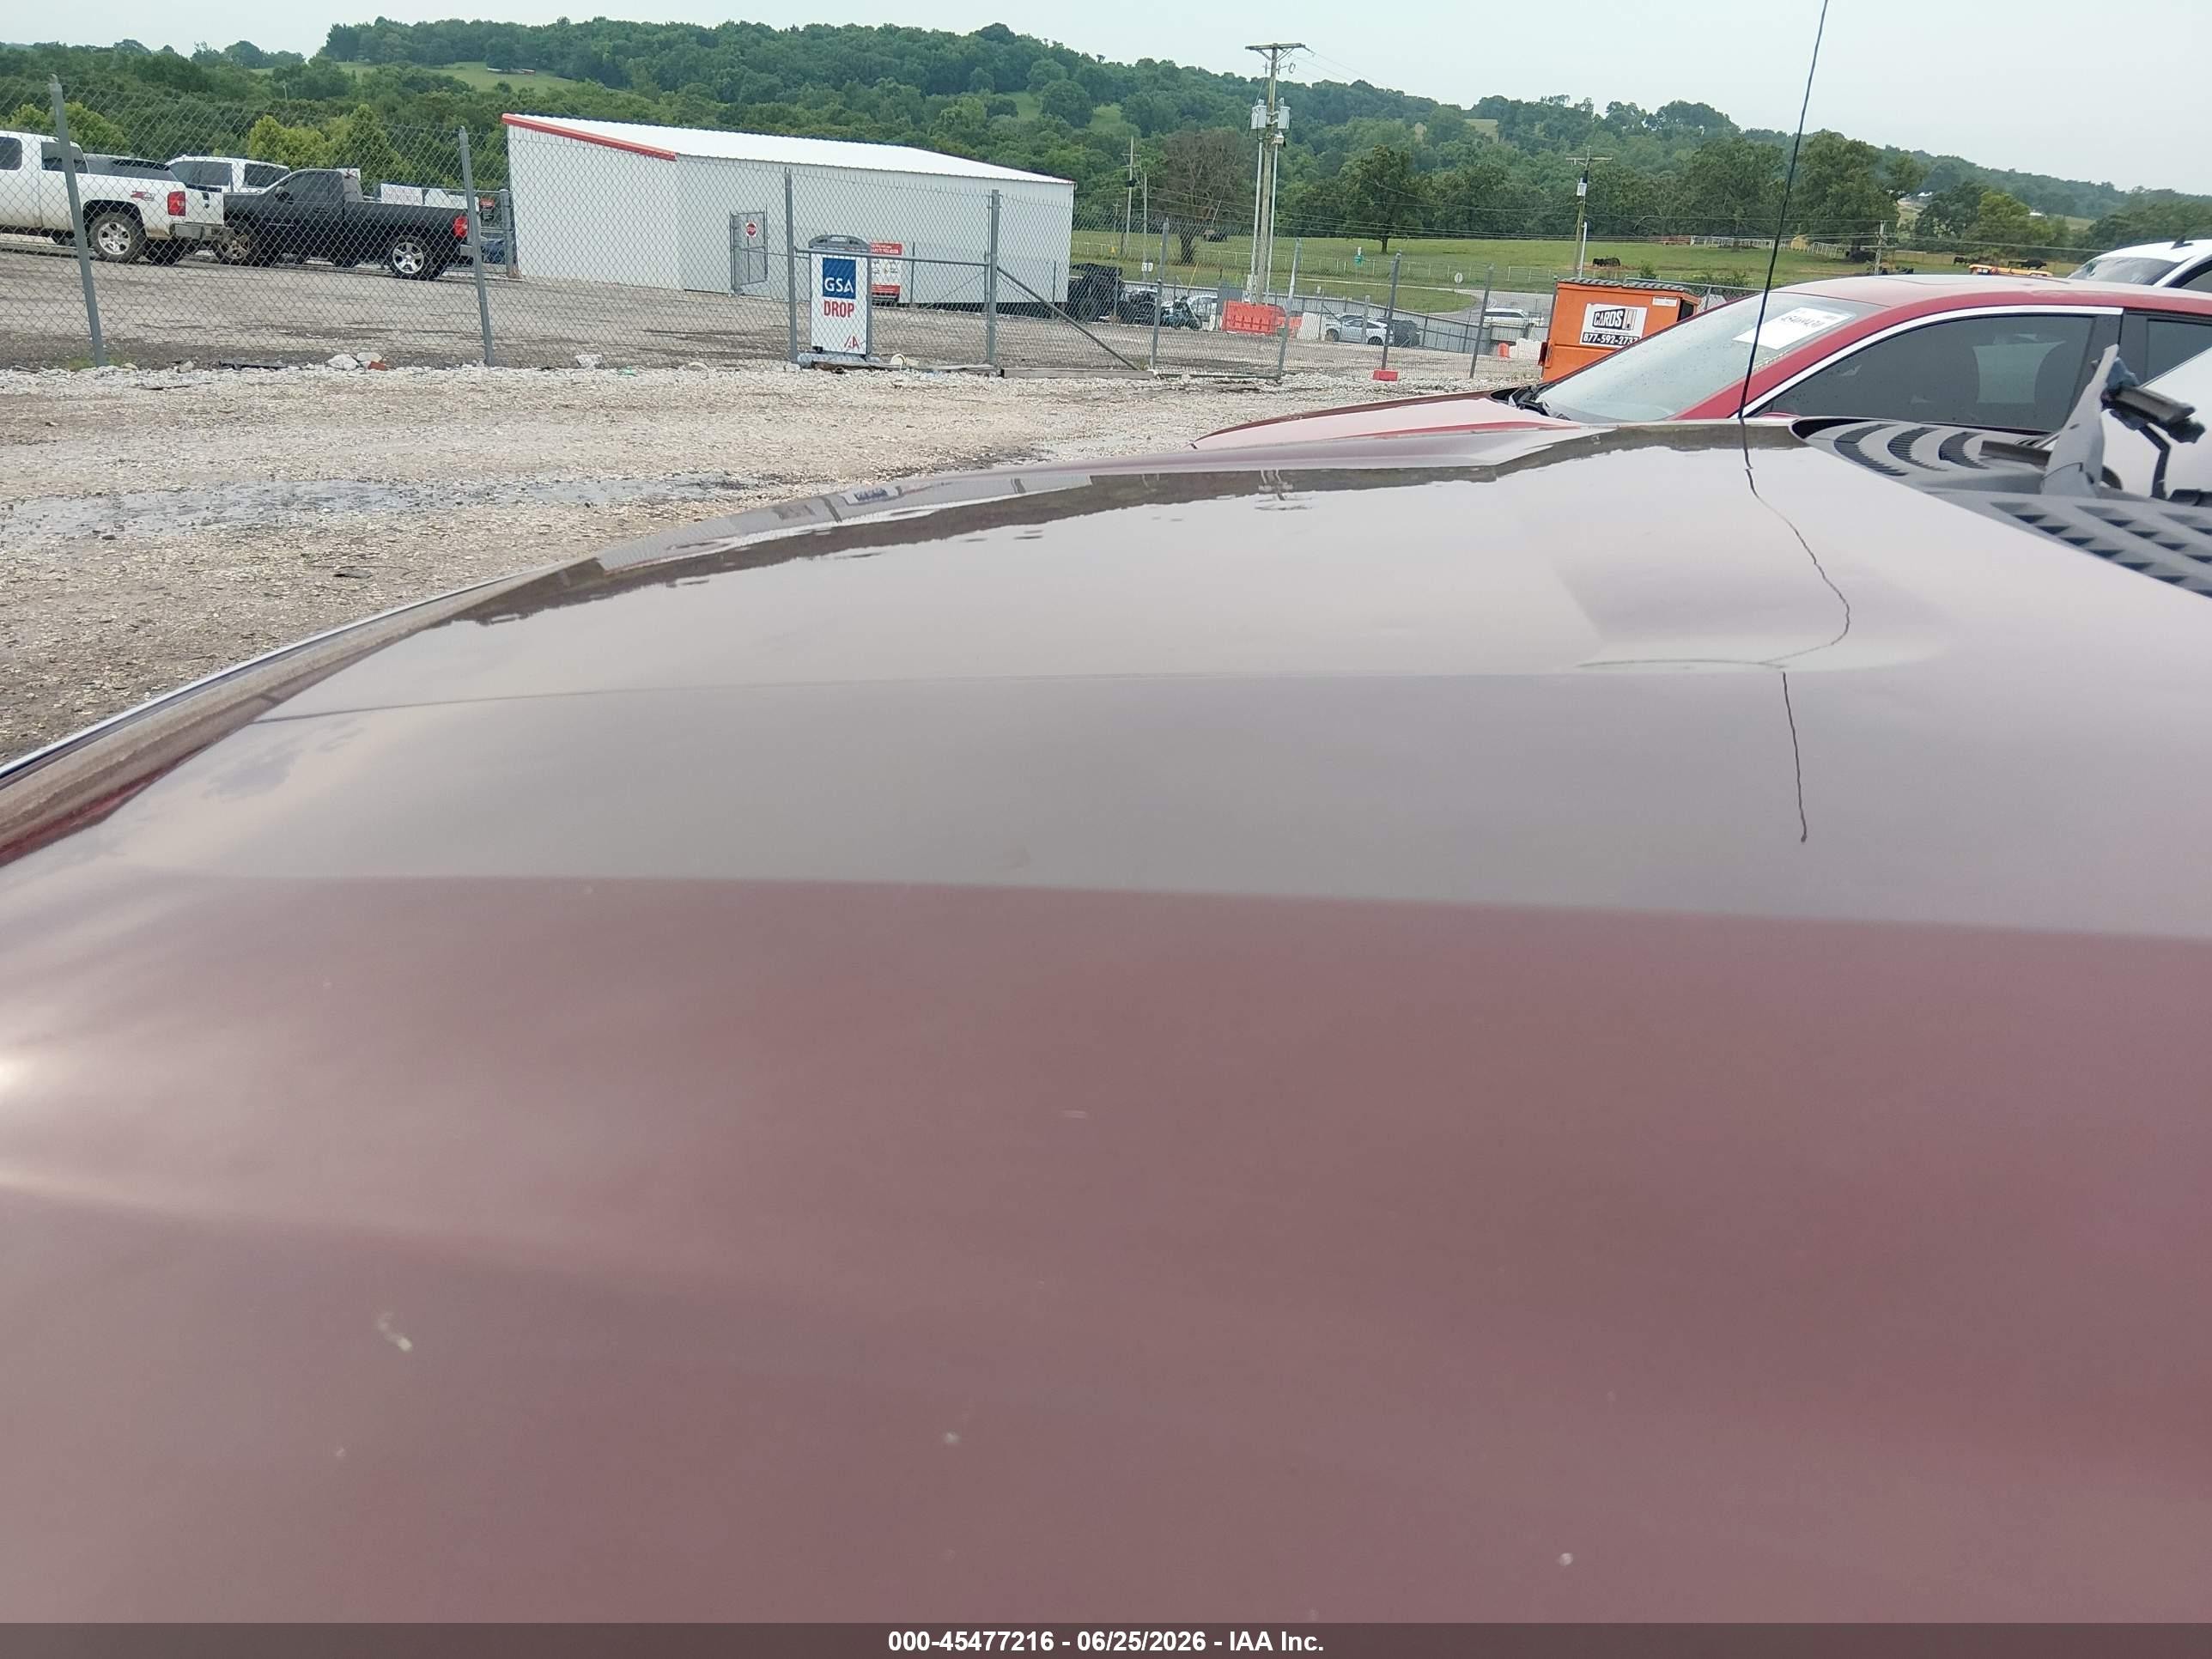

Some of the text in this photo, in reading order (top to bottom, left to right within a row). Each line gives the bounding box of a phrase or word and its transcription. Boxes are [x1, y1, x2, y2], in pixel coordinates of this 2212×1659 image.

[824, 276, 854, 294] GSA
[824, 301, 855, 318] DROP
[1593, 310, 1624, 327] CARDS
